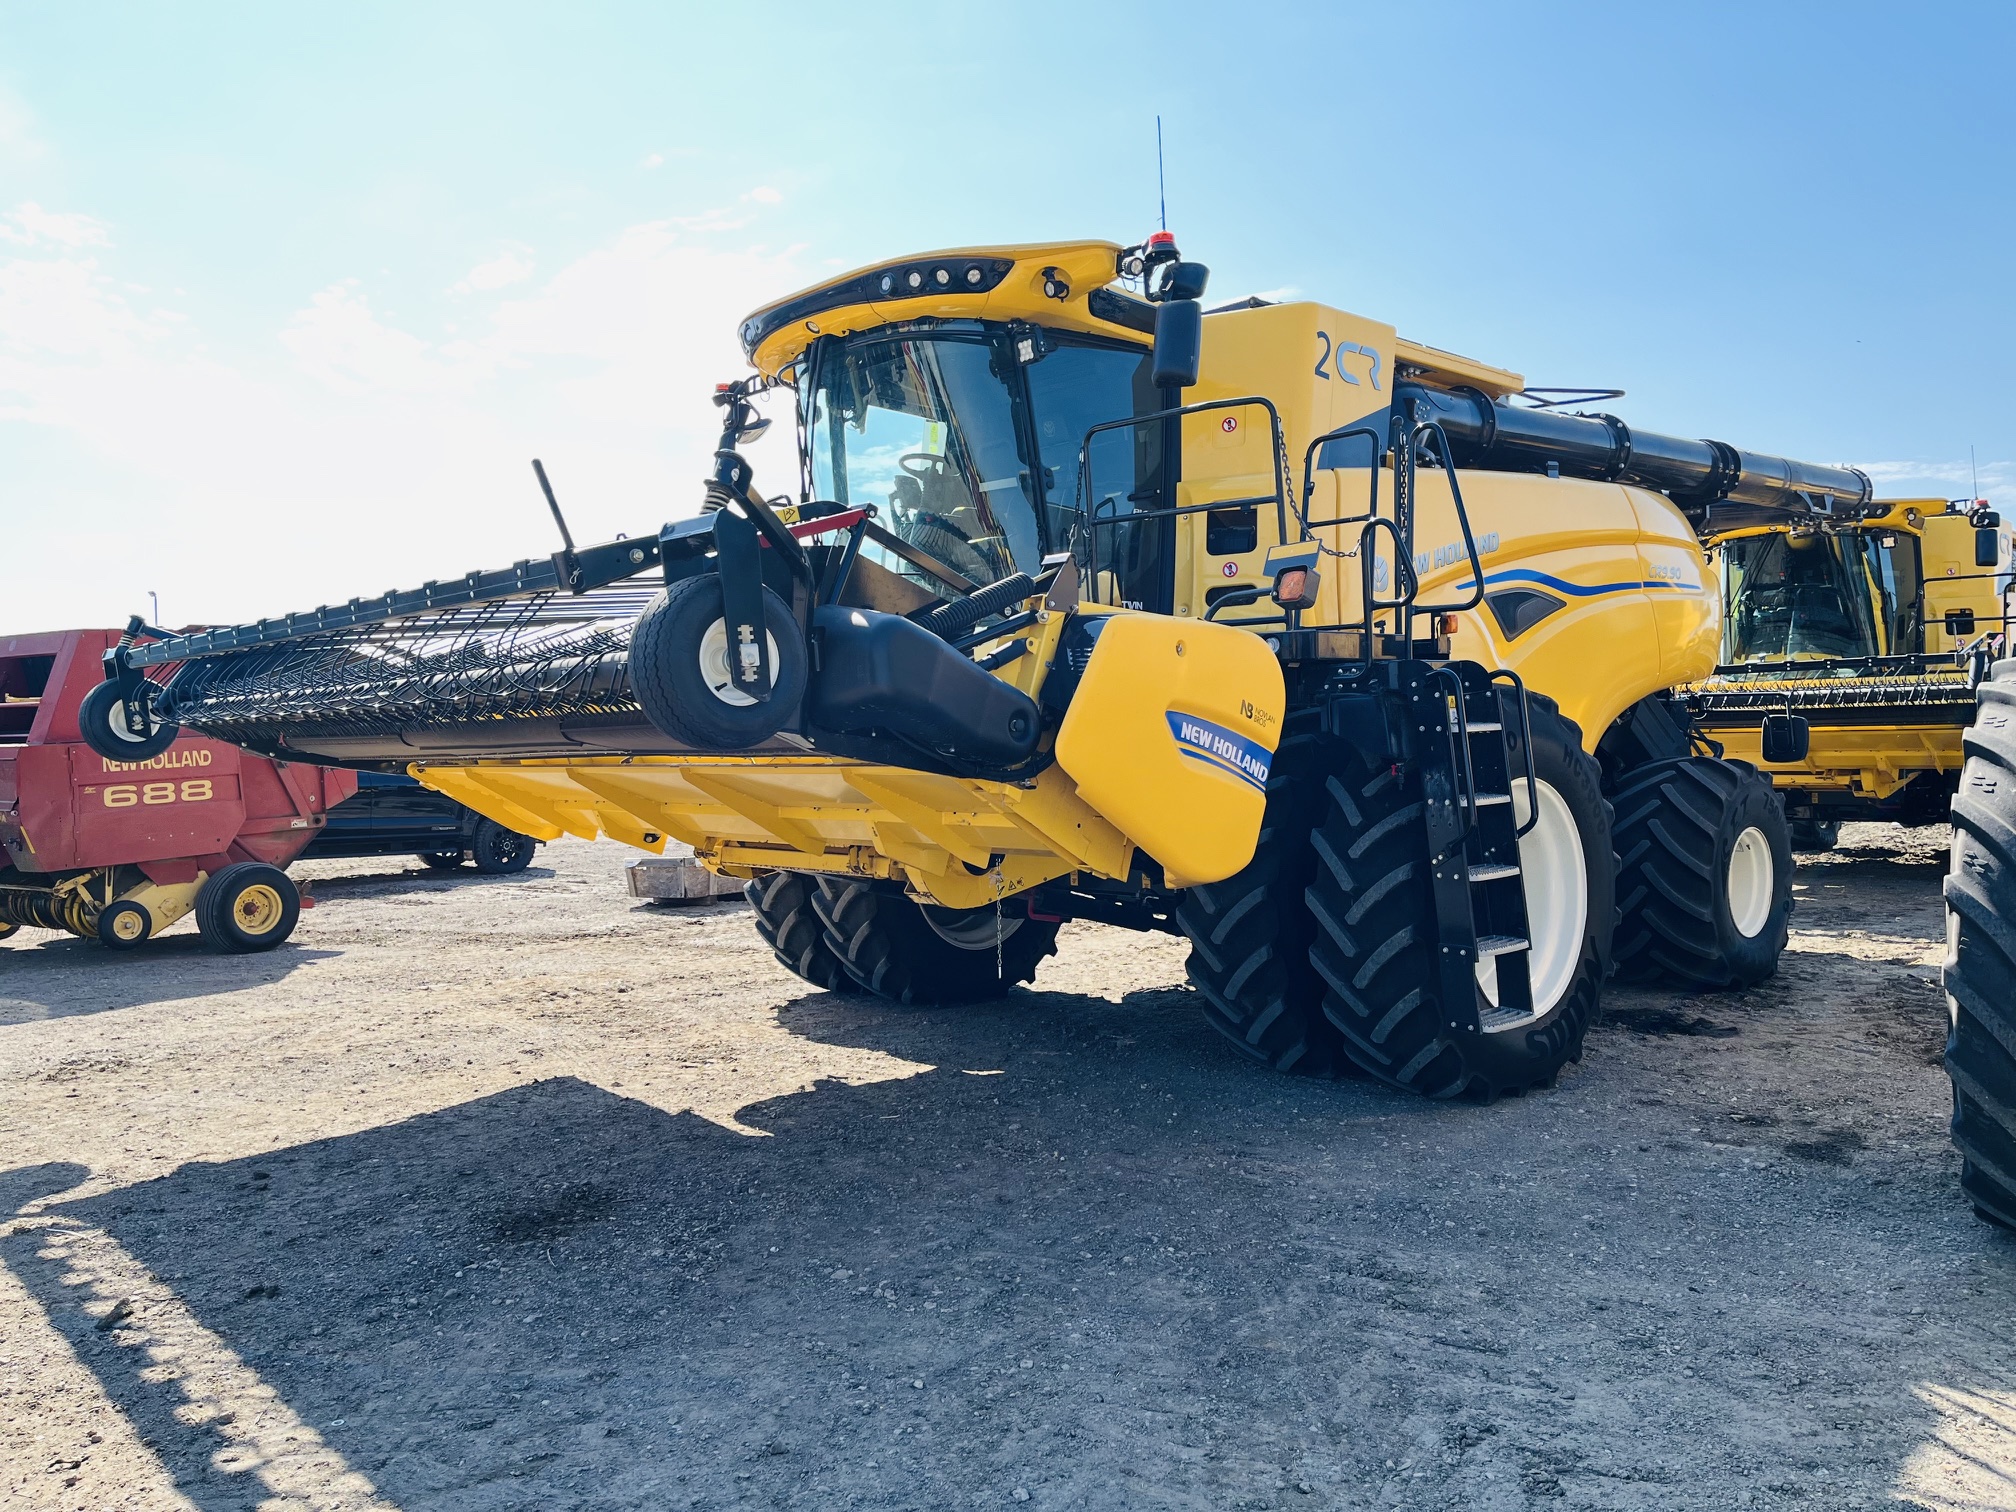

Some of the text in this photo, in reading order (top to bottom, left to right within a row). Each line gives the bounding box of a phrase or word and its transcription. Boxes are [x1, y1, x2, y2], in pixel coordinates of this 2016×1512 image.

[140, 749, 212, 770] HOLLAND
[1181, 722, 1268, 783] NEW HOLLAND
[103, 779, 213, 808] 688
